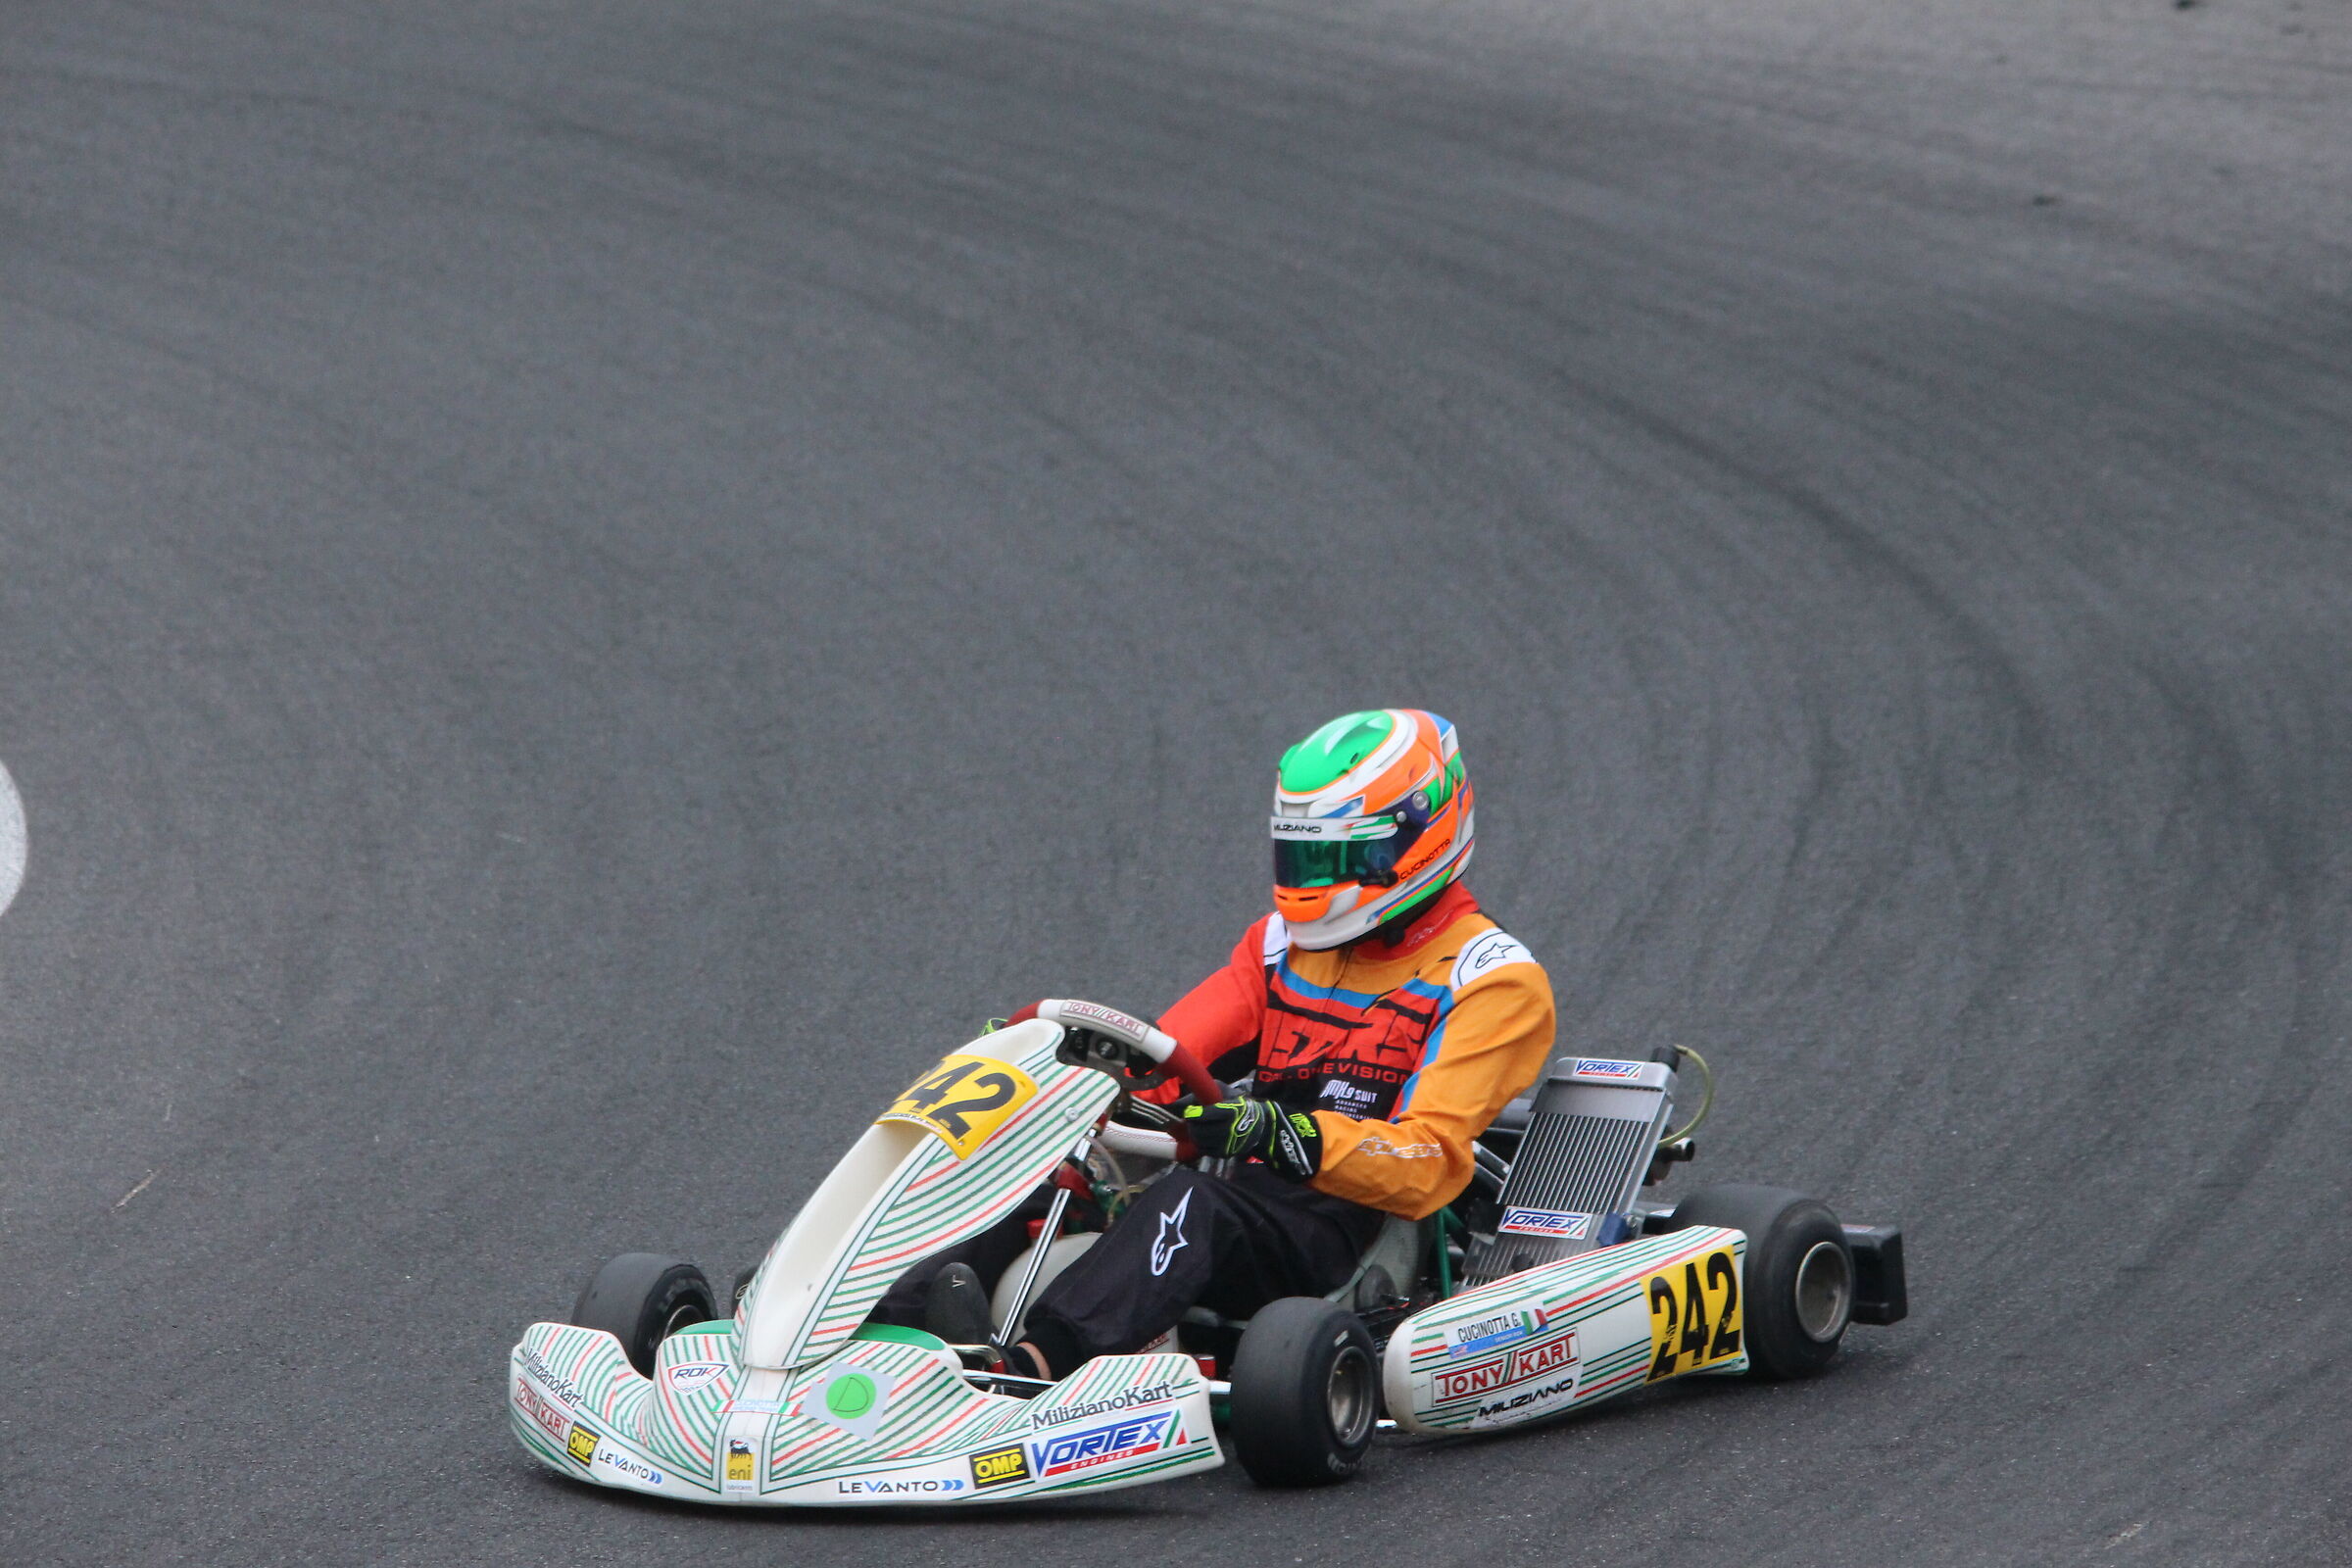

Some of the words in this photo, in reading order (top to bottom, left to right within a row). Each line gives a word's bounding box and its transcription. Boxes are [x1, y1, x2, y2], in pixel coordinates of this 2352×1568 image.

[1399, 838, 1450, 880] CUCINOTTA
[1576, 1059, 1642, 1074] VORTEX
[894, 1060, 1016, 1140] 42
[1354, 1089, 1378, 1103] SUIT
[1502, 1208, 1585, 1230] VORTEX
[1457, 1315, 1510, 1343] CUCINOTTA
[1646, 1251, 1740, 1382] 242
[673, 1366, 718, 1379] ROK
[1032, 1381, 1173, 1431] MilizianoKart
[1478, 1378, 1574, 1417] MILIZIANO
[568, 1431, 596, 1457] OMP
[1031, 1410, 1174, 1478] VORTEX
[728, 1463, 753, 1481] eni
[975, 1453, 1023, 1479] OMP
[1070, 1449, 1135, 1470] ENGINES
